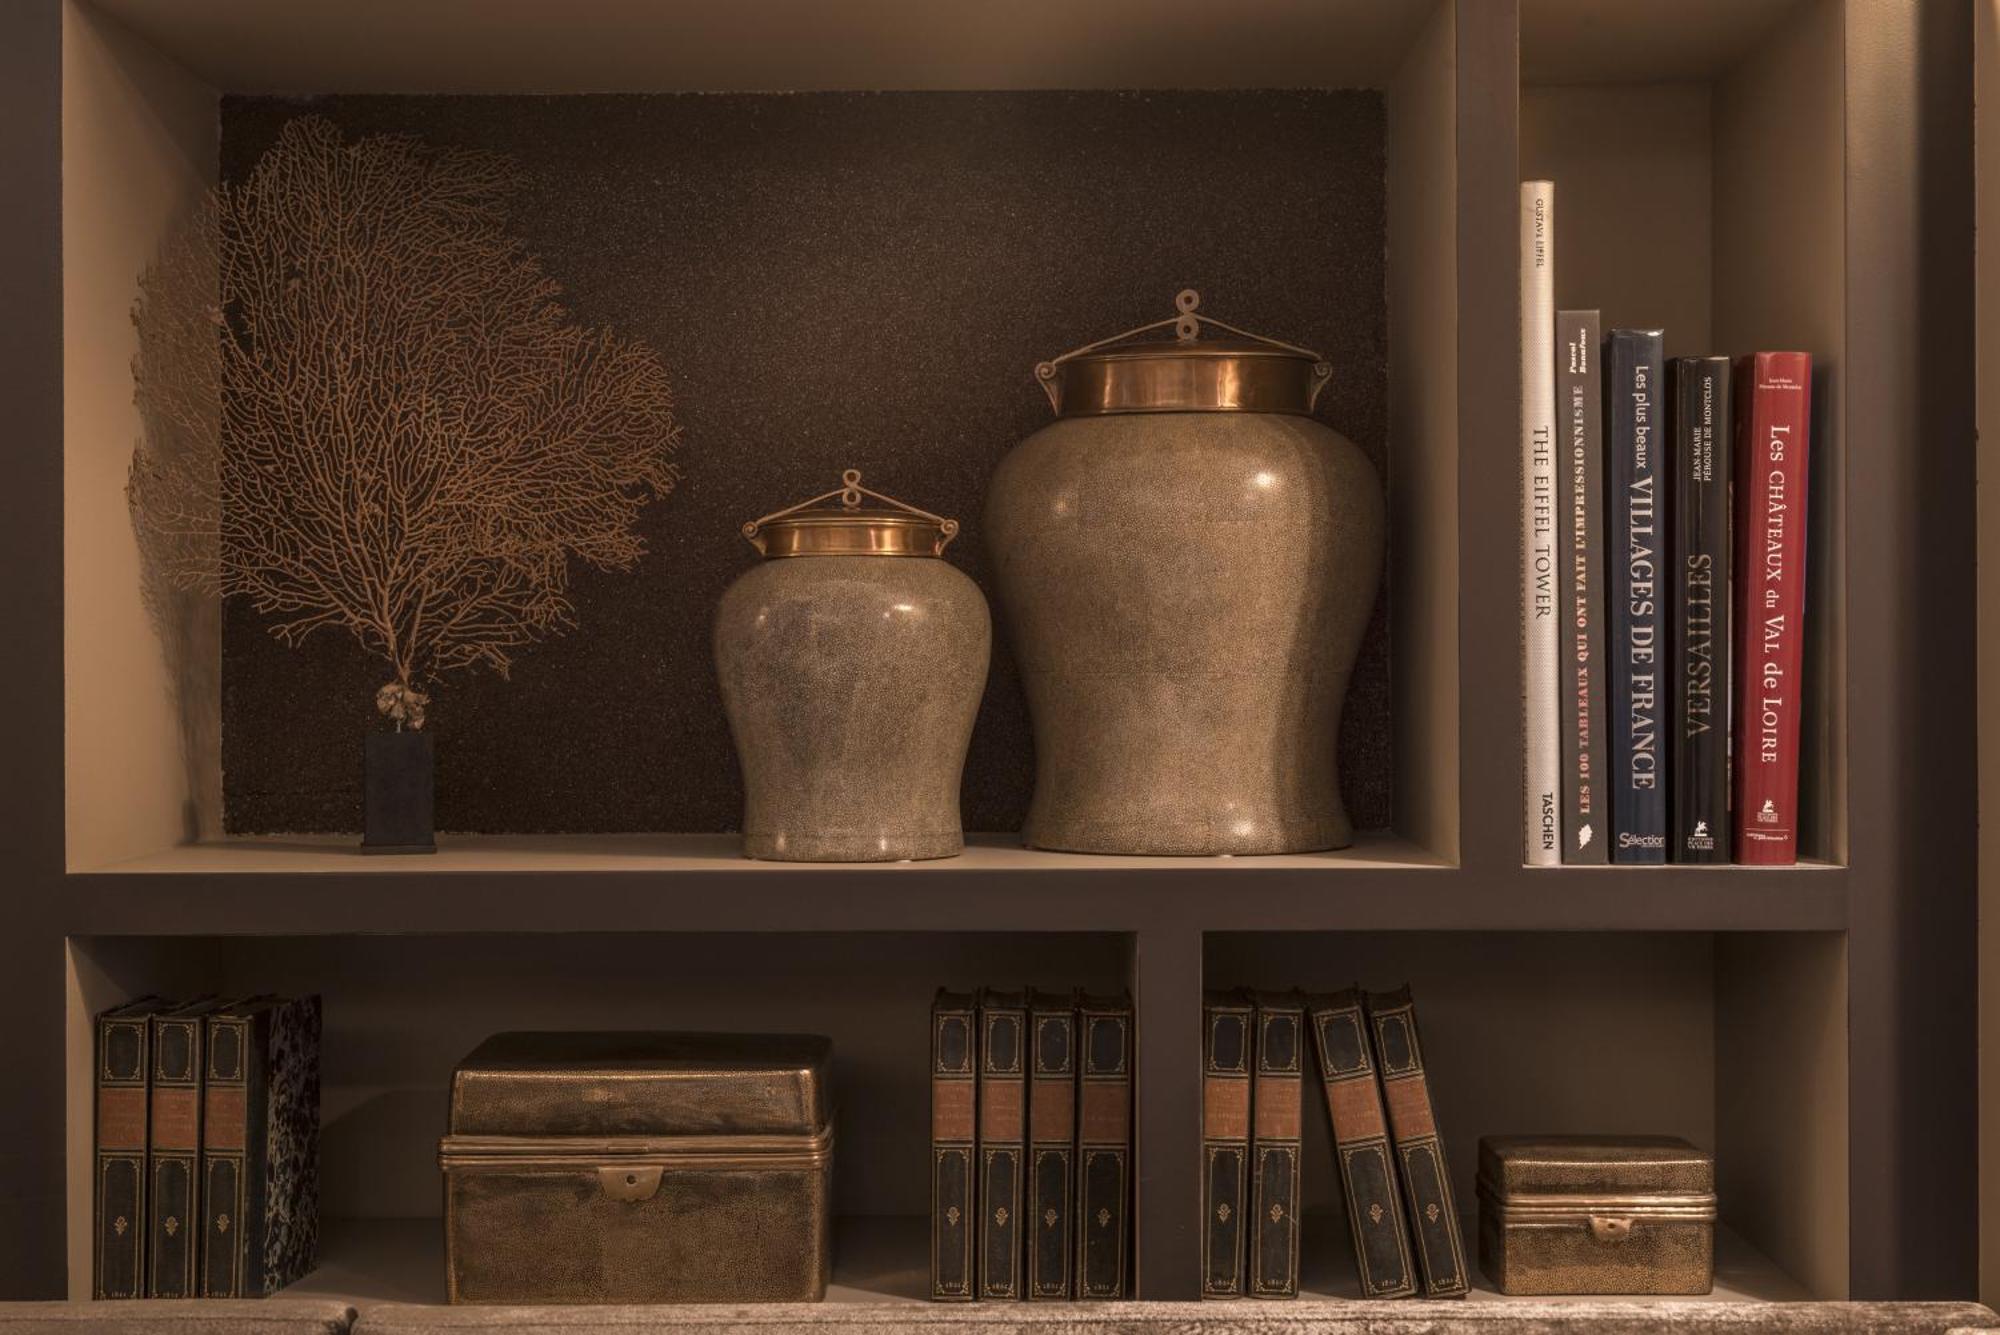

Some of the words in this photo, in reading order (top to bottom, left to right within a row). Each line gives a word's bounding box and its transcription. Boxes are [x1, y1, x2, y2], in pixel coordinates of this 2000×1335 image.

[1536, 198, 1544, 238] GUSTAVE
[1536, 241, 1544, 268] EIFFEL
[1635, 366, 1649, 389] Les
[1632, 393, 1649, 425] plus
[1703, 376, 1711, 424] MONTCLOS
[1534, 426, 1549, 466] THE
[1635, 426, 1650, 469] beaux
[1703, 426, 1711, 439] DE
[1770, 425, 1790, 461] Les
[1693, 427, 1701, 481] JEAN-MARIE
[1703, 442, 1712, 481] PÉROUSE
[1534, 476, 1550, 538] EIFFEL
[1767, 471, 1785, 581] CHÂTEAUX
[1630, 475, 1654, 616] VILLAGES
[1535, 545, 1552, 619] TOWER
[1576, 555, 1586, 591] FAIT
[1576, 596, 1587, 628] ONT
[1766, 590, 1779, 608] du
[1577, 634, 1589, 662] QUI
[1631, 625, 1654, 664] DE
[1688, 553, 1711, 738] VERSAILLES
[1765, 615, 1784, 653] VAL
[1764, 662, 1782, 689] de
[1578, 667, 1589, 748] TABLEAUX
[1631, 673, 1656, 790] FRANCE
[1762, 698, 1782, 762] LOIRE
[1579, 753, 1590, 779] 100
[1579, 786, 1590, 814] LES
[1542, 792, 1554, 850] TASCHEN
